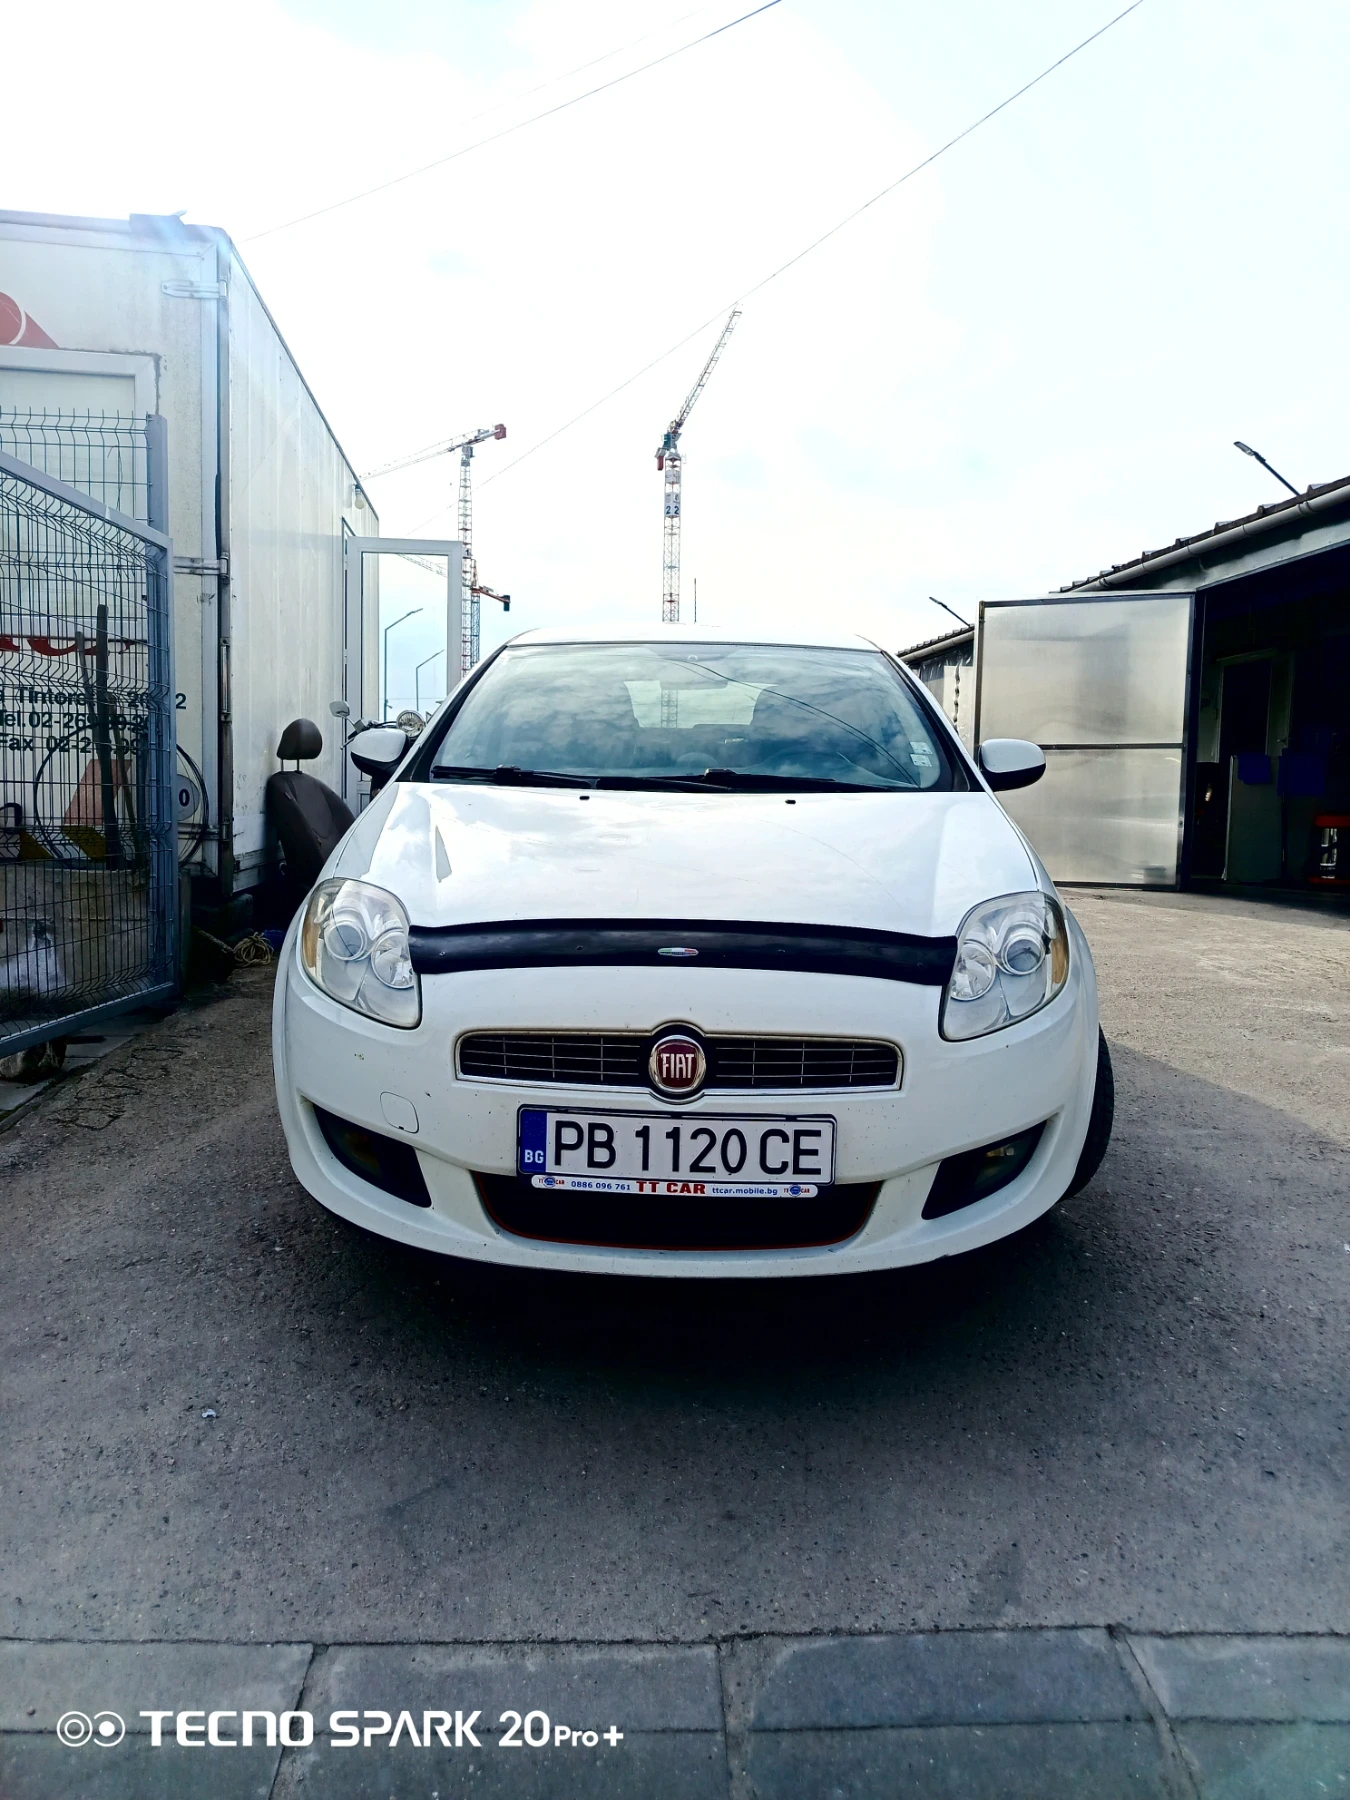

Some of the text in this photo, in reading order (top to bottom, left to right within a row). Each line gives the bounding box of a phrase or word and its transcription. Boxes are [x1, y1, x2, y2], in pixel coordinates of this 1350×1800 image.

[660, 1053, 695, 1079] FIAT
[524, 1119, 822, 1176] BG PB 1120 CE
[571, 1180, 593, 1189] 0886
[595, 1181, 612, 1190] 096
[615, 1183, 631, 1191] 761
[636, 1180, 660, 1193] TT
[666, 1182, 706, 1195] CAR
[712, 1186, 778, 1196] ttcar.mobile.bg
